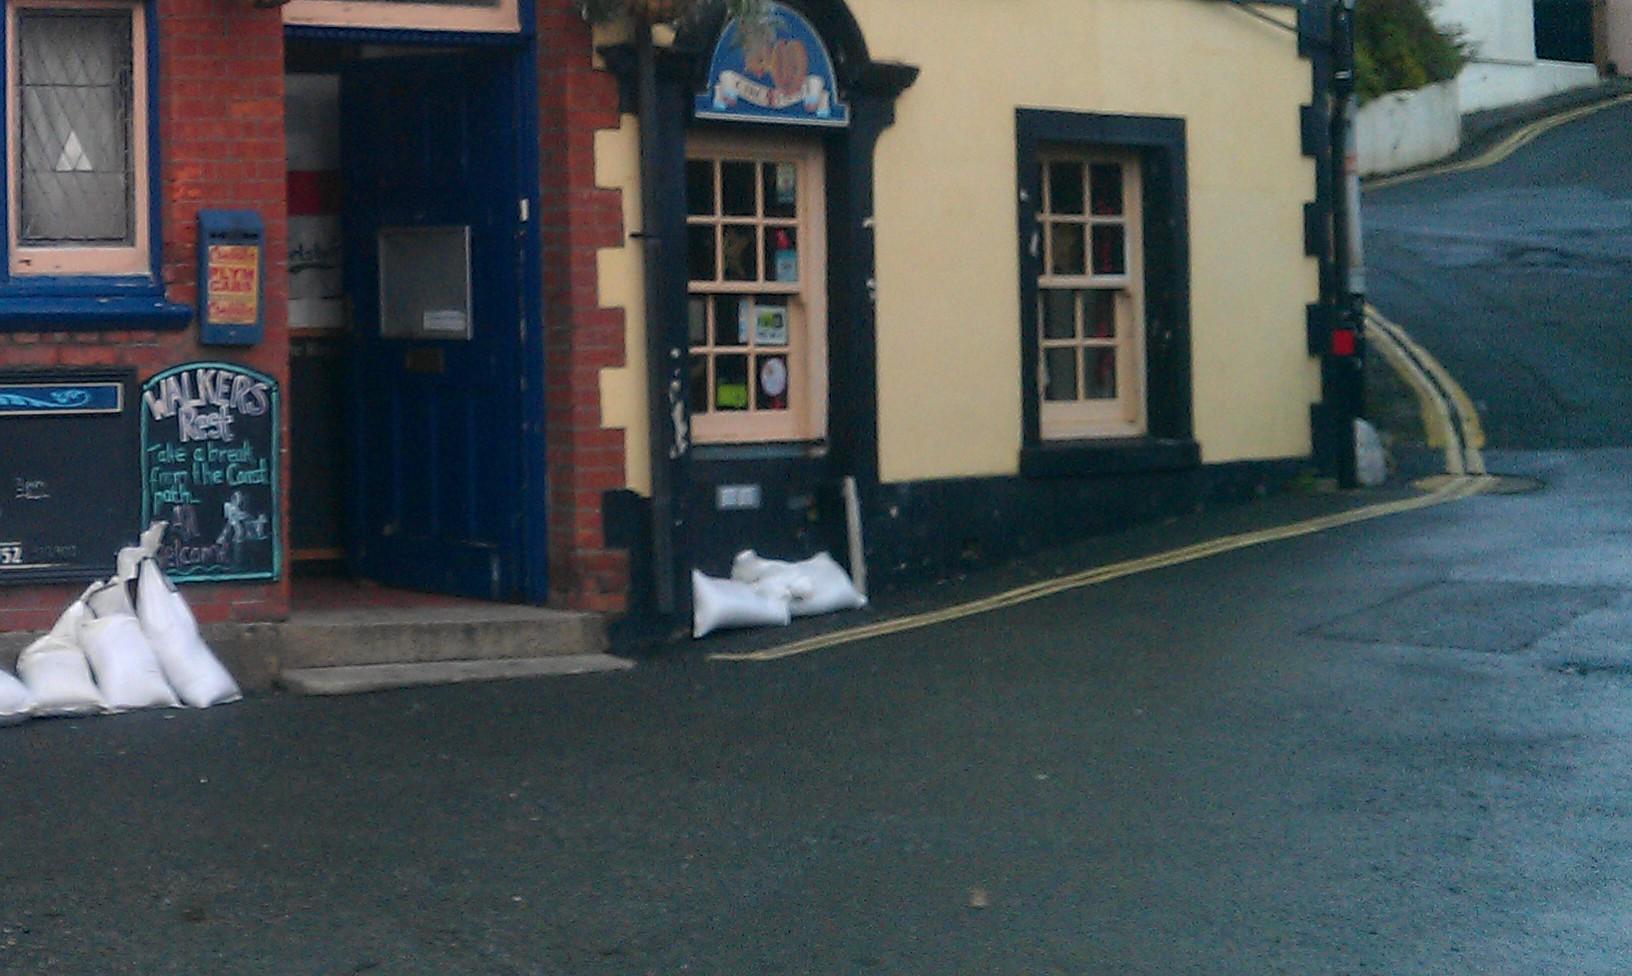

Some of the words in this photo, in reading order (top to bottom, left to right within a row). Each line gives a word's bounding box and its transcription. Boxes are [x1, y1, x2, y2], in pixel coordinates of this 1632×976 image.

[144, 369, 268, 420] WALKERS
[179, 404, 235, 442] Rest
[192, 462, 223, 484] the
